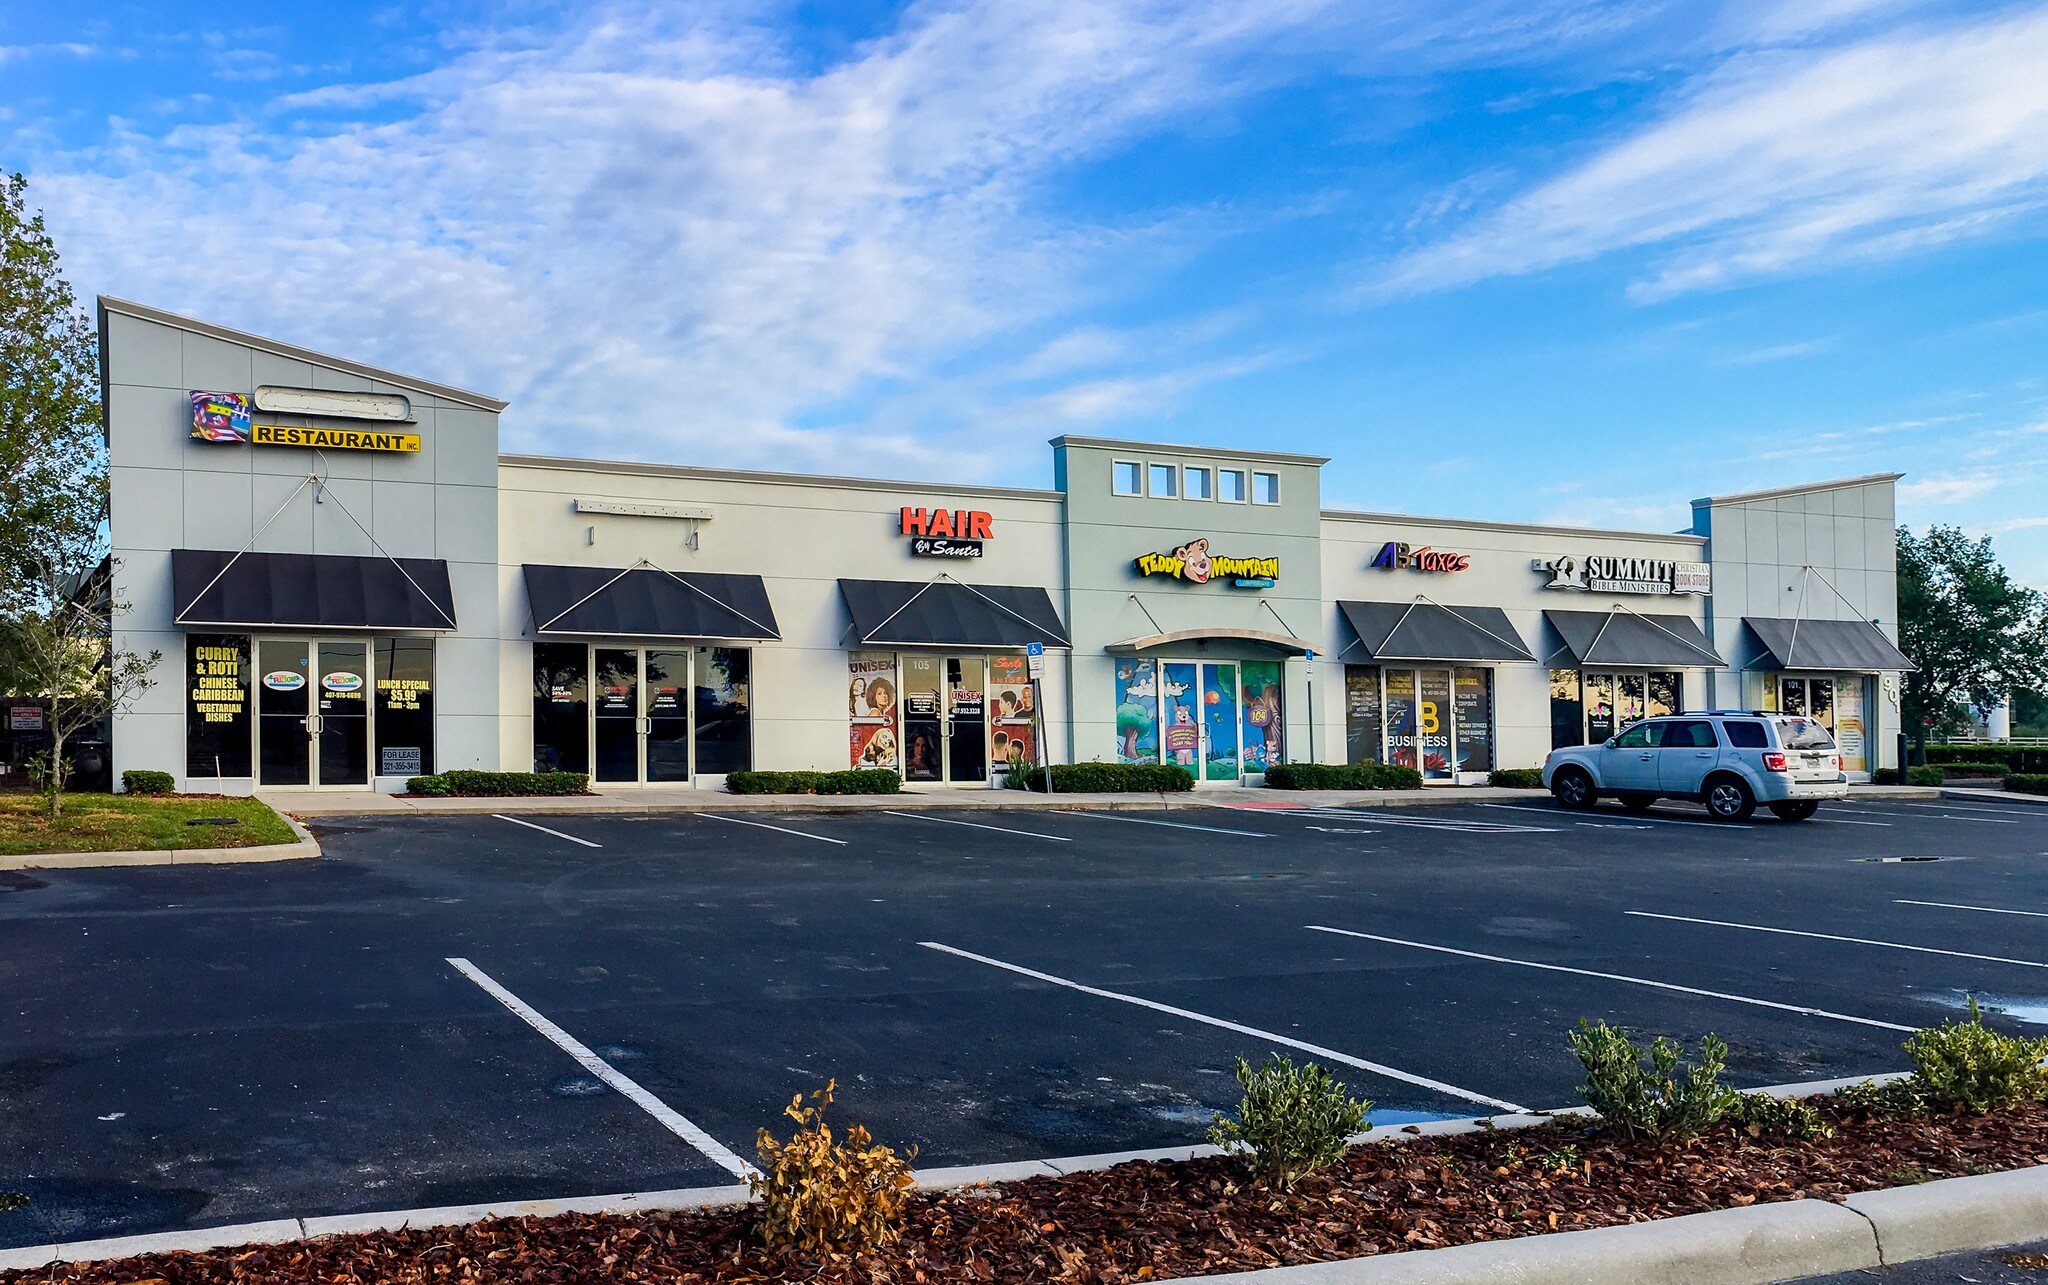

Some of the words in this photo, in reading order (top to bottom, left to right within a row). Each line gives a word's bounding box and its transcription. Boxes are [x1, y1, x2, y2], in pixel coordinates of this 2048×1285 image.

[257, 427, 404, 449] RESTAURANT
[407, 442, 418, 450] INC.
[901, 507, 994, 539] HAIR
[931, 541, 980, 556] Santa
[1370, 541, 1411, 568] AB
[1410, 546, 1471, 573] Taxes
[1137, 552, 1184, 579] TEDDY
[1210, 555, 1279, 579] MOUNTAIN
[1588, 556, 1673, 582] SUMMIT
[1676, 562, 1709, 573] CHRISTIAN
[1676, 574, 1691, 585] BOOK
[1692, 574, 1709, 586] STORE
[1592, 580, 1616, 591] BIBLE
[1618, 580, 1669, 593] MINISTRIES
[196, 646, 239, 661] CURRY
[196, 663, 206, 675] &
[208, 661, 238, 675] ROTI
[849, 660, 893, 673] UNISEX
[913, 660, 930, 670] 105
[199, 677, 238, 689] CHINESE
[377, 680, 401, 689] LUNCH
[402, 680, 429, 690] SPECIAL
[1787, 680, 1798, 689] 101
[192, 689, 244, 701] CARIBBEAN
[390, 690, 416, 701] $5.99
[951, 691, 981, 700] UNISEX
[196, 703, 242, 713] VEGETARIAN
[387, 701, 402, 709] 11am
[406, 701, 420, 710] 3pm
[205, 712, 233, 722] DISHES
[1251, 710, 1267, 721] 104
[1388, 735, 1448, 747] BUSINESS
[383, 751, 397, 759] FOR
[398, 751, 419, 759] LEASE
